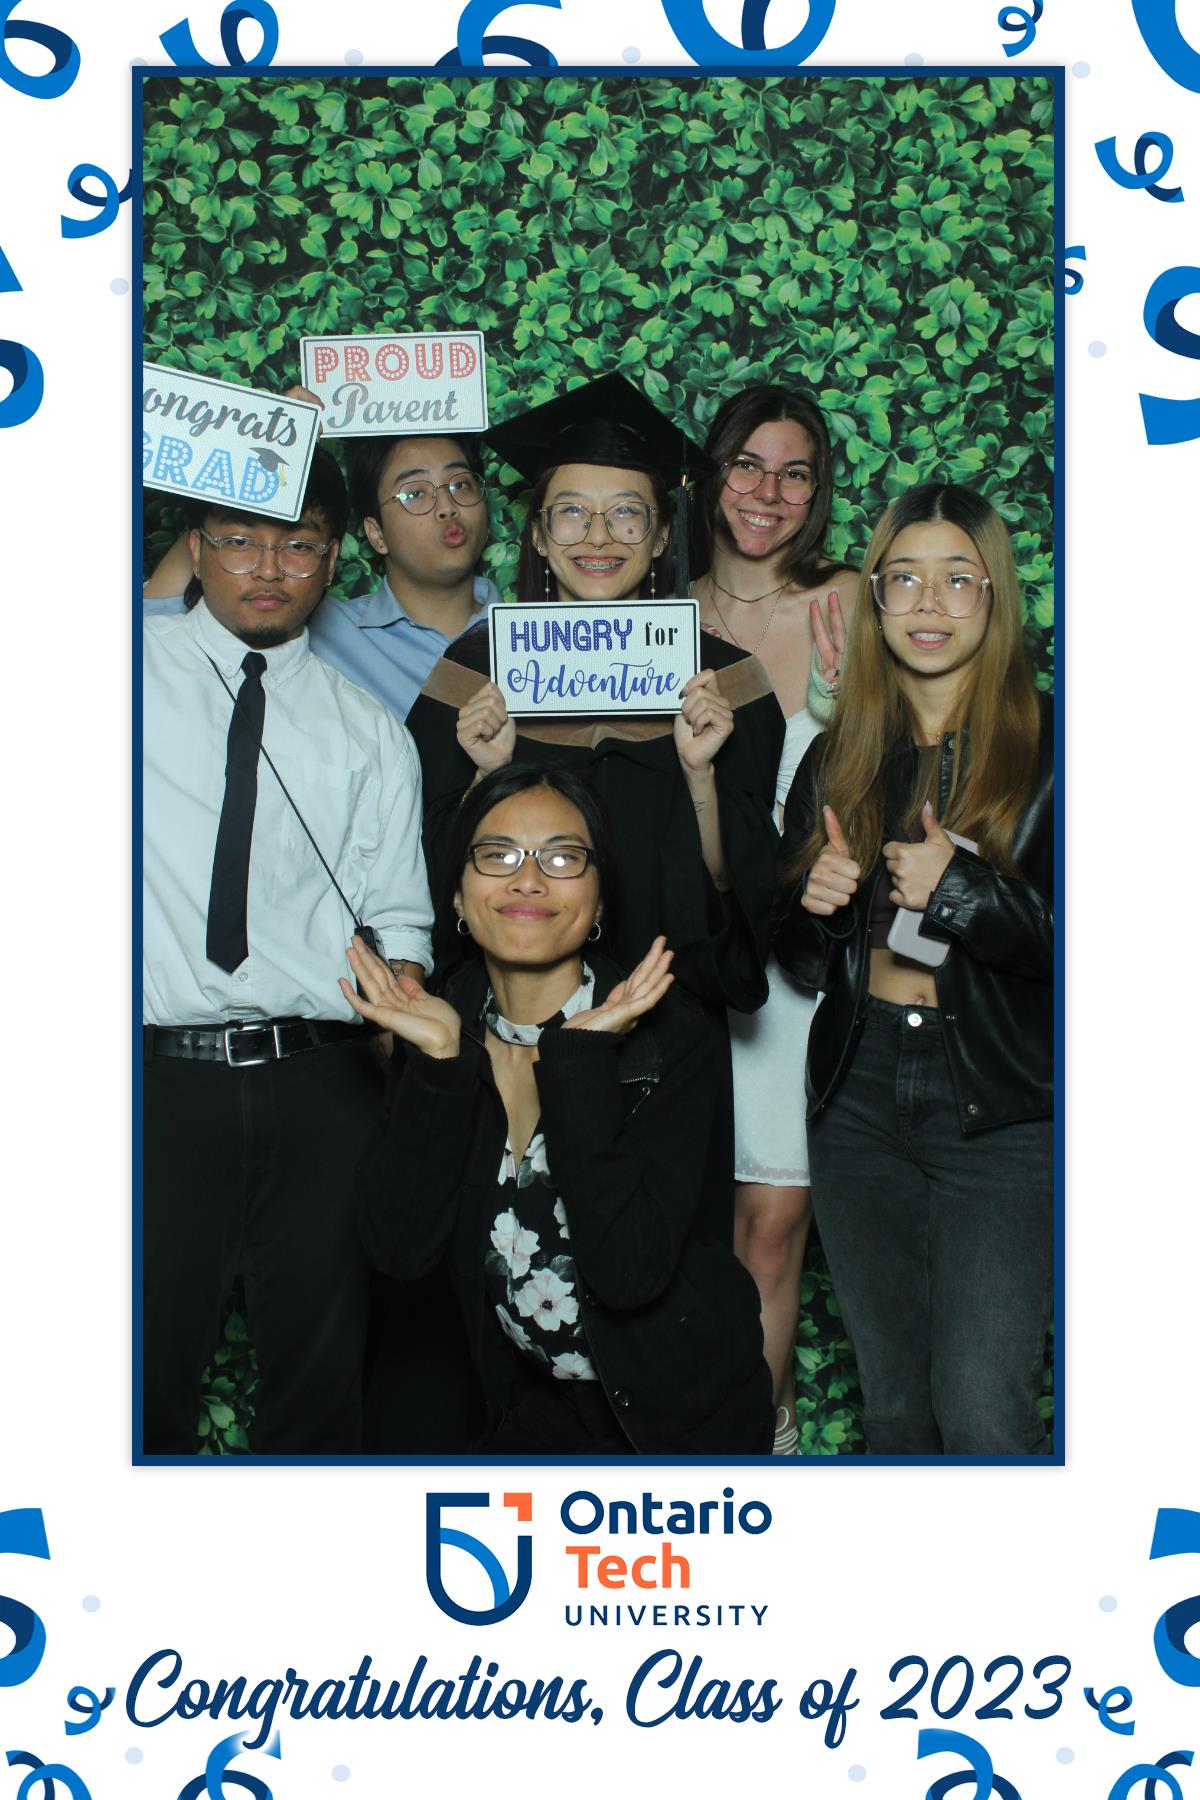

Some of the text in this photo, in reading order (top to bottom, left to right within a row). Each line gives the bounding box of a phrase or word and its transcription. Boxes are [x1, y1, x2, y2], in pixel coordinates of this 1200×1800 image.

[314, 342, 477, 384] PROUD
[143, 387, 298, 447] ongrats
[327, 382, 460, 429] Parent
[510, 618, 679, 653] HUNGRY for
[506, 658, 681, 705] Adventure
